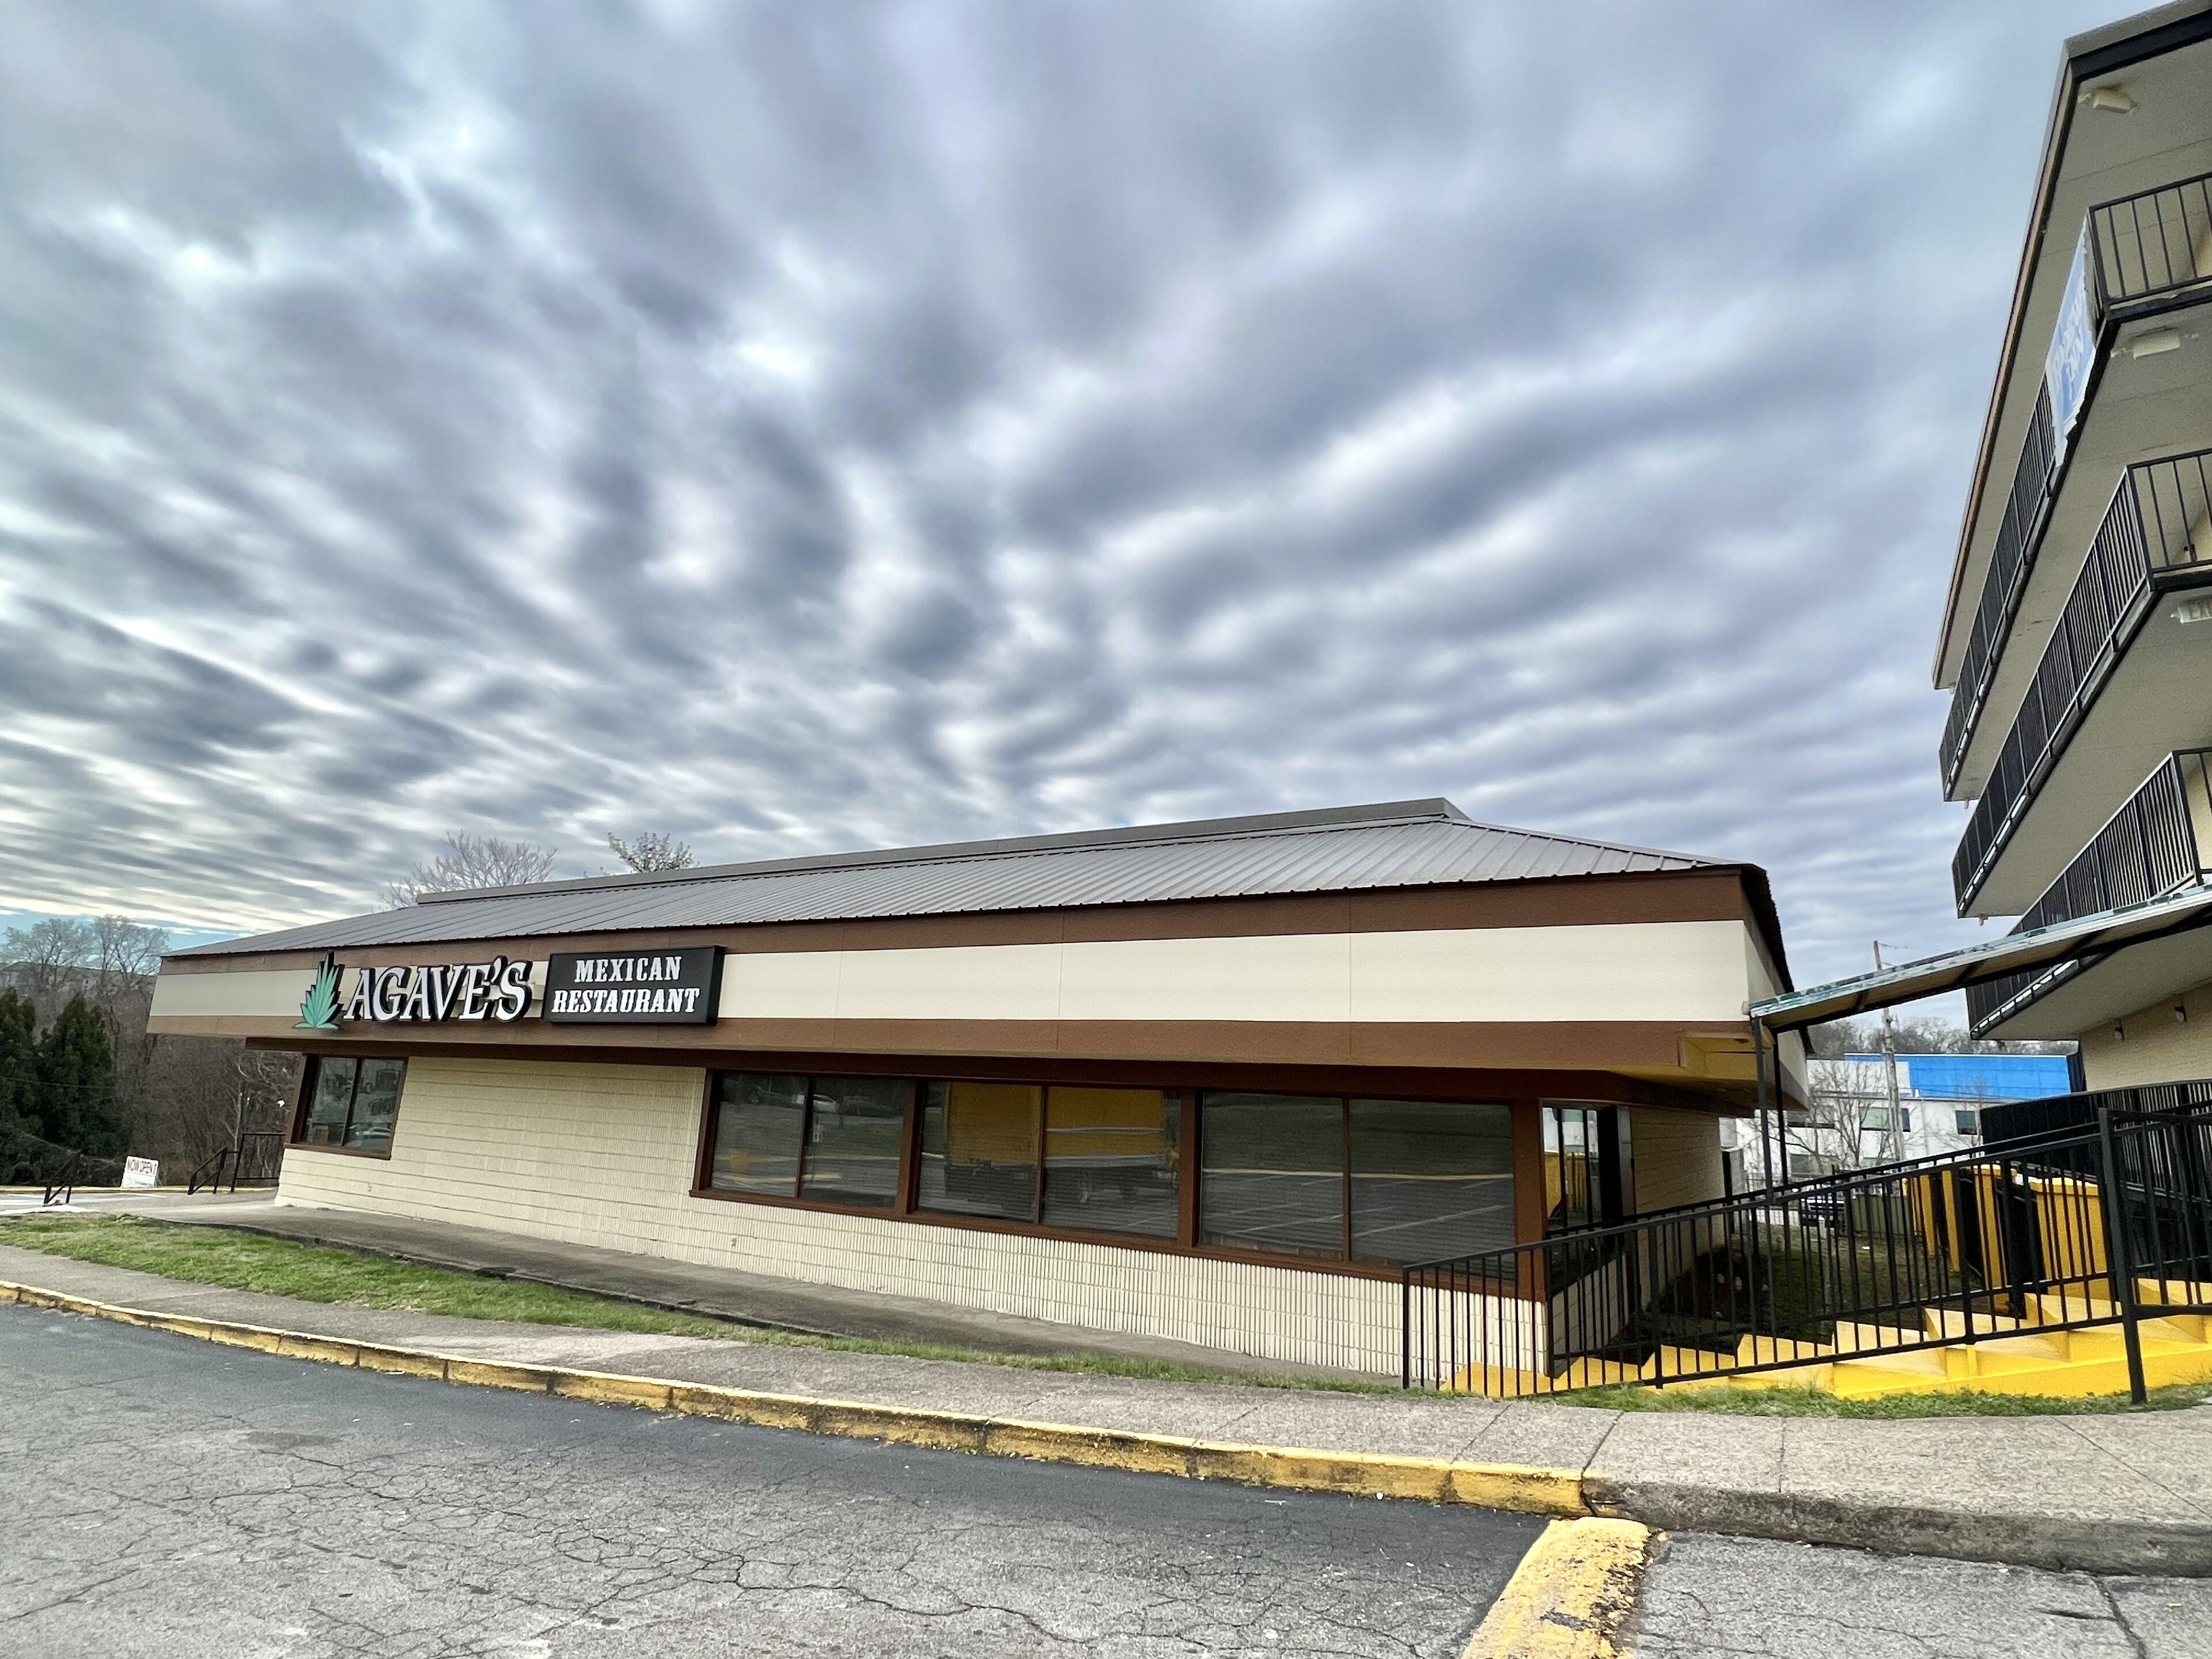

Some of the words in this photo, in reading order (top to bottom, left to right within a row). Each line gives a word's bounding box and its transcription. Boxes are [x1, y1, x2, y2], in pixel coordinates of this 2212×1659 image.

[574, 956, 681, 982] MEXICAN
[343, 956, 529, 1021] AGAVE'S
[552, 988, 700, 1013] RESTAURANT
